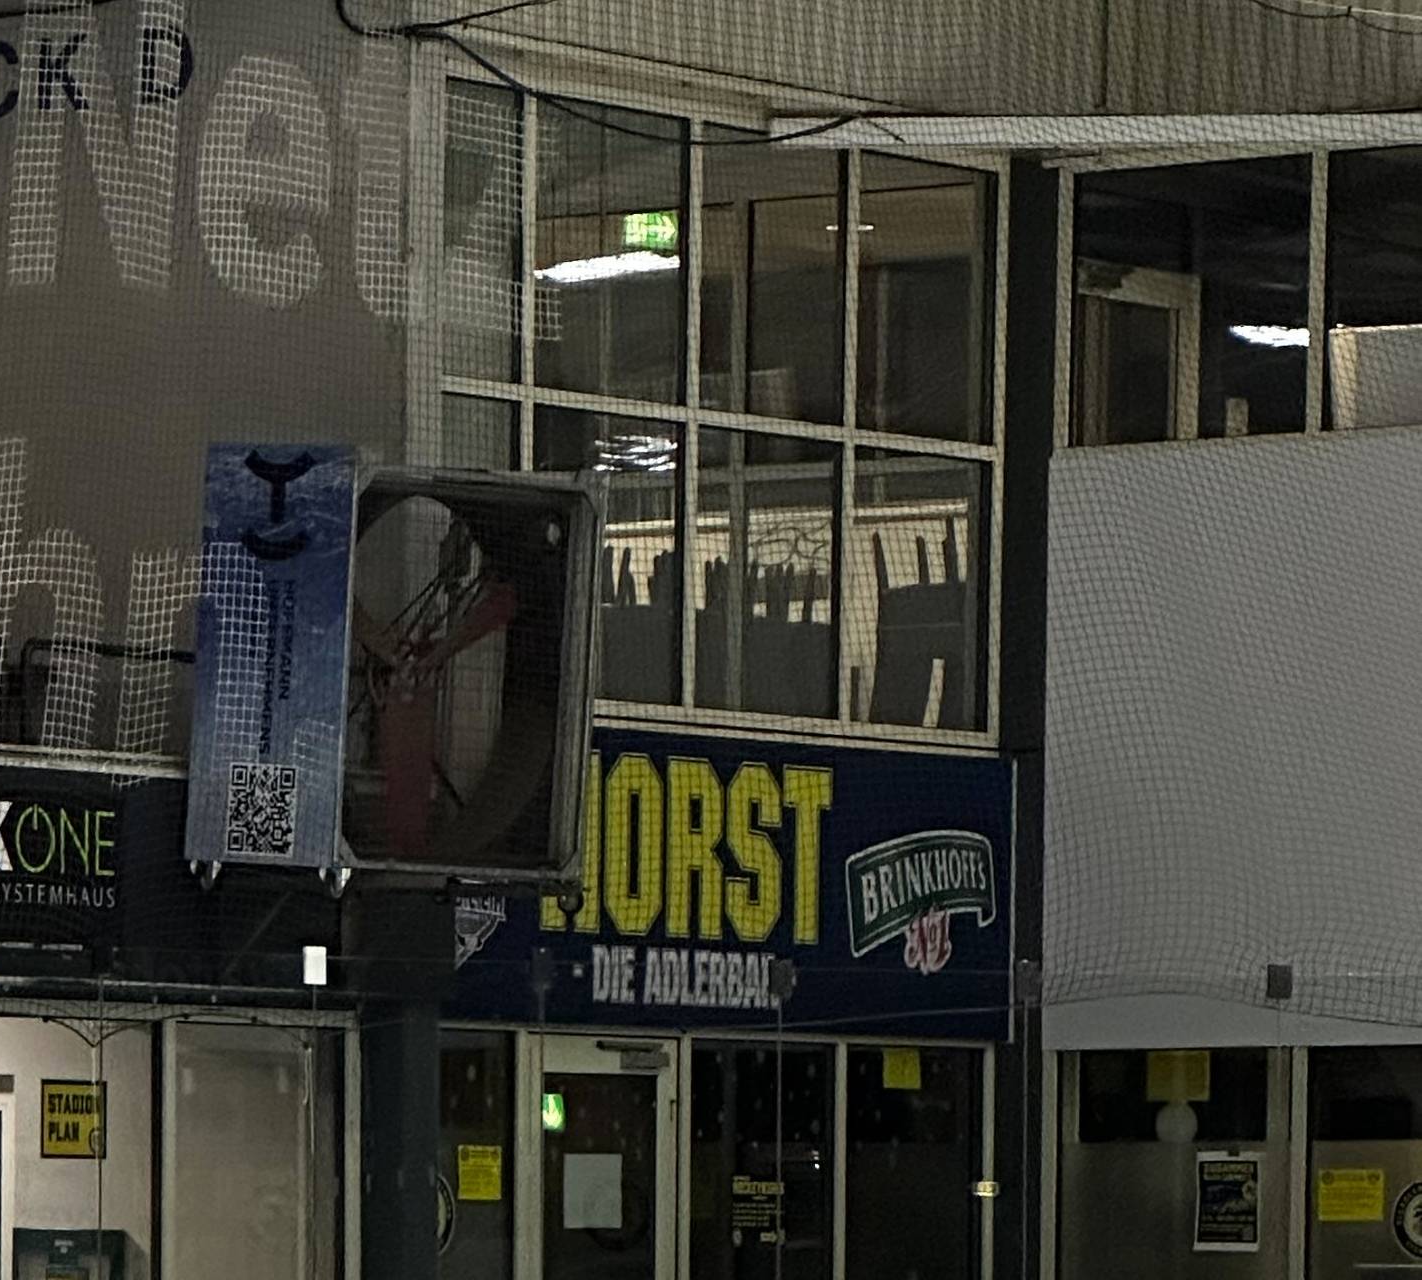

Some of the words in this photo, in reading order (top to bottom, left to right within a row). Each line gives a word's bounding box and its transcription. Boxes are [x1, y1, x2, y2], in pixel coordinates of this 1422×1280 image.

[141, 27, 193, 105] D
[592, 943, 636, 1005] DIE
[48, 1121, 80, 1143] PLAN
